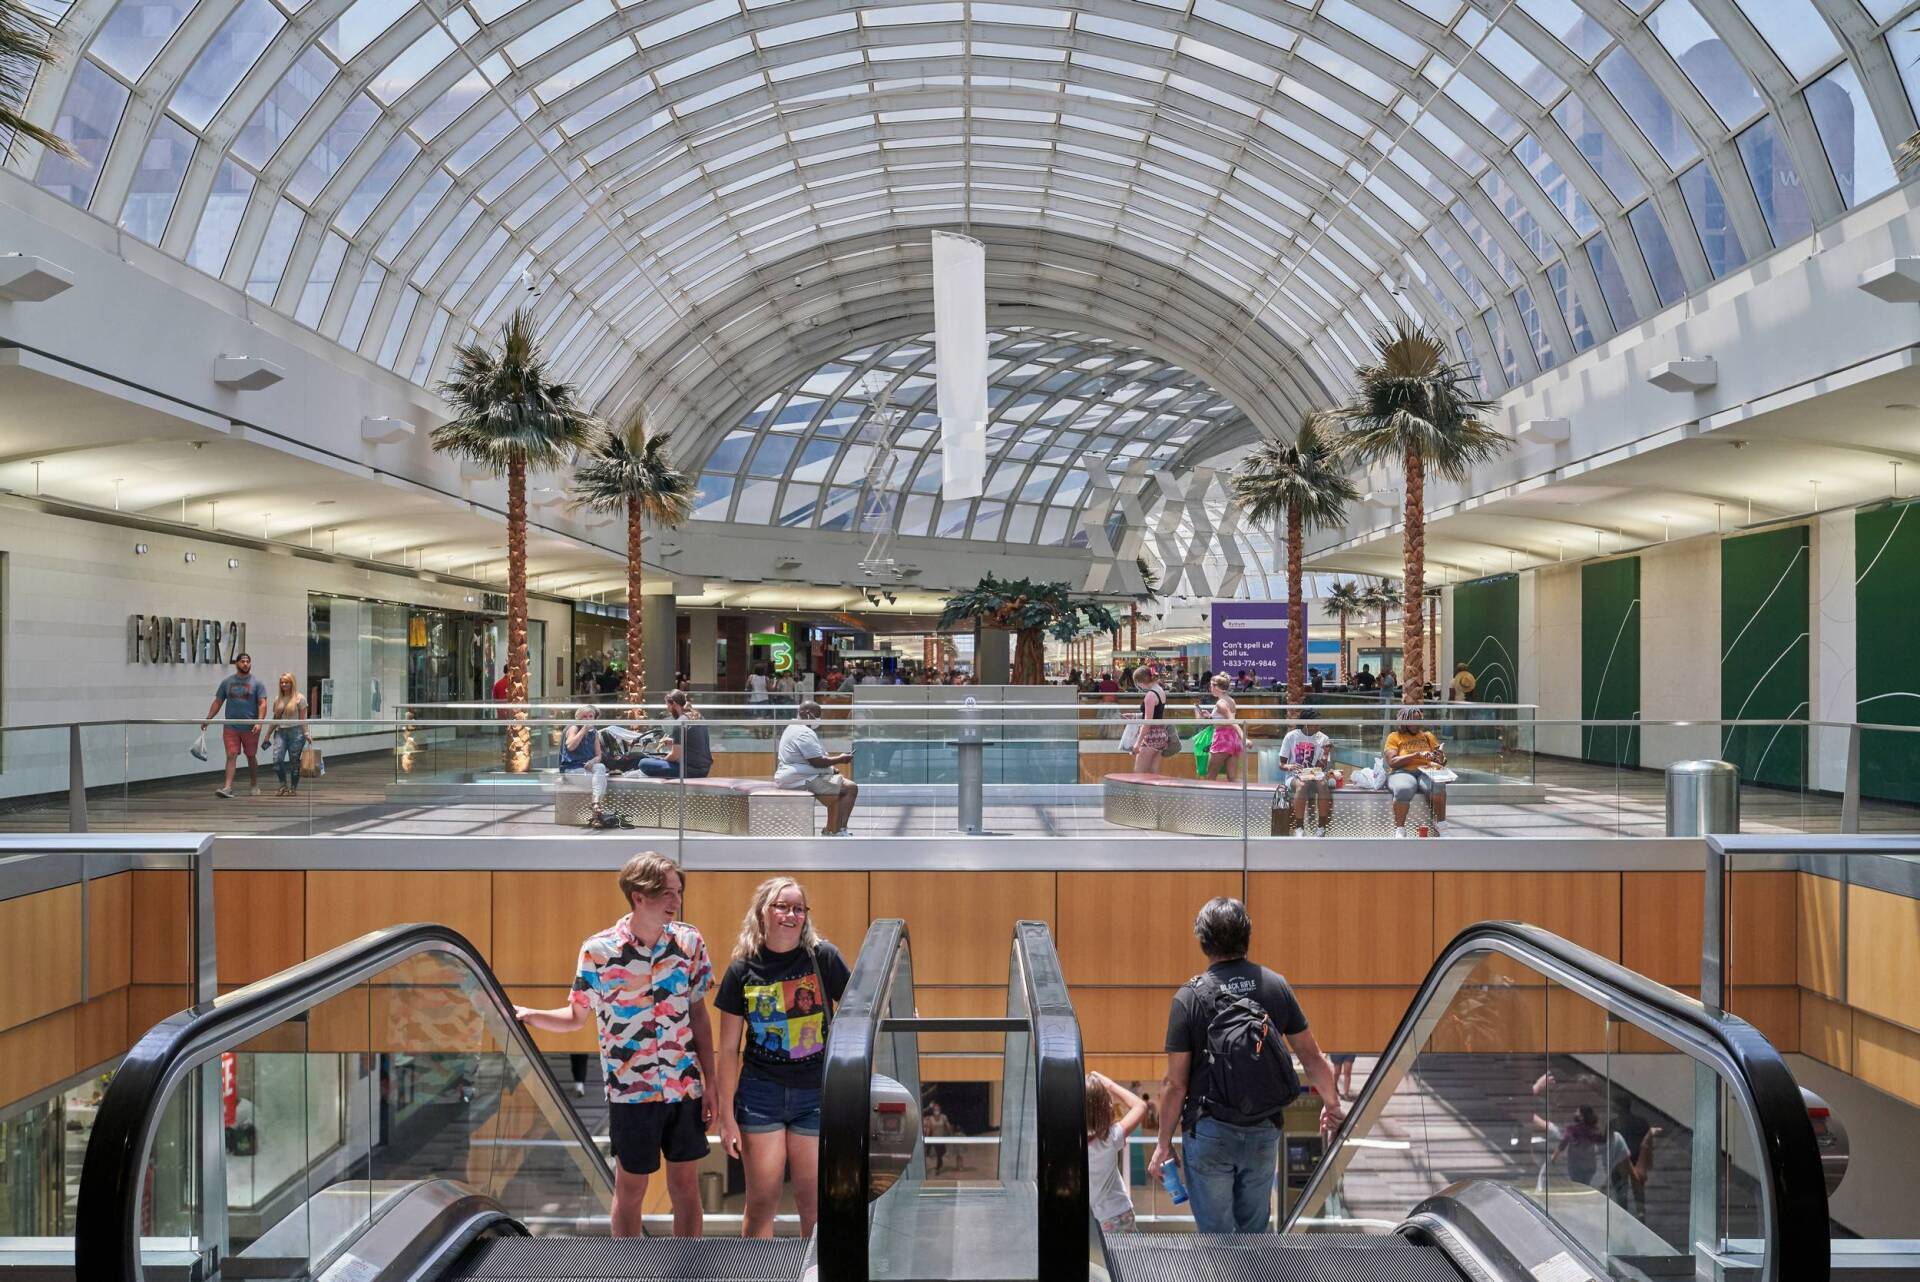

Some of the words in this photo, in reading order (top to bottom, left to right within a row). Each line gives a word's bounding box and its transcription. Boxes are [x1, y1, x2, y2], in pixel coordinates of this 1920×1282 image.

[127, 614, 222, 664] FOREVER
[225, 620, 246, 664] 21
[1222, 641, 1242, 649] Can't
[1243, 641, 1261, 650] spell
[1262, 641, 1274, 649] us?
